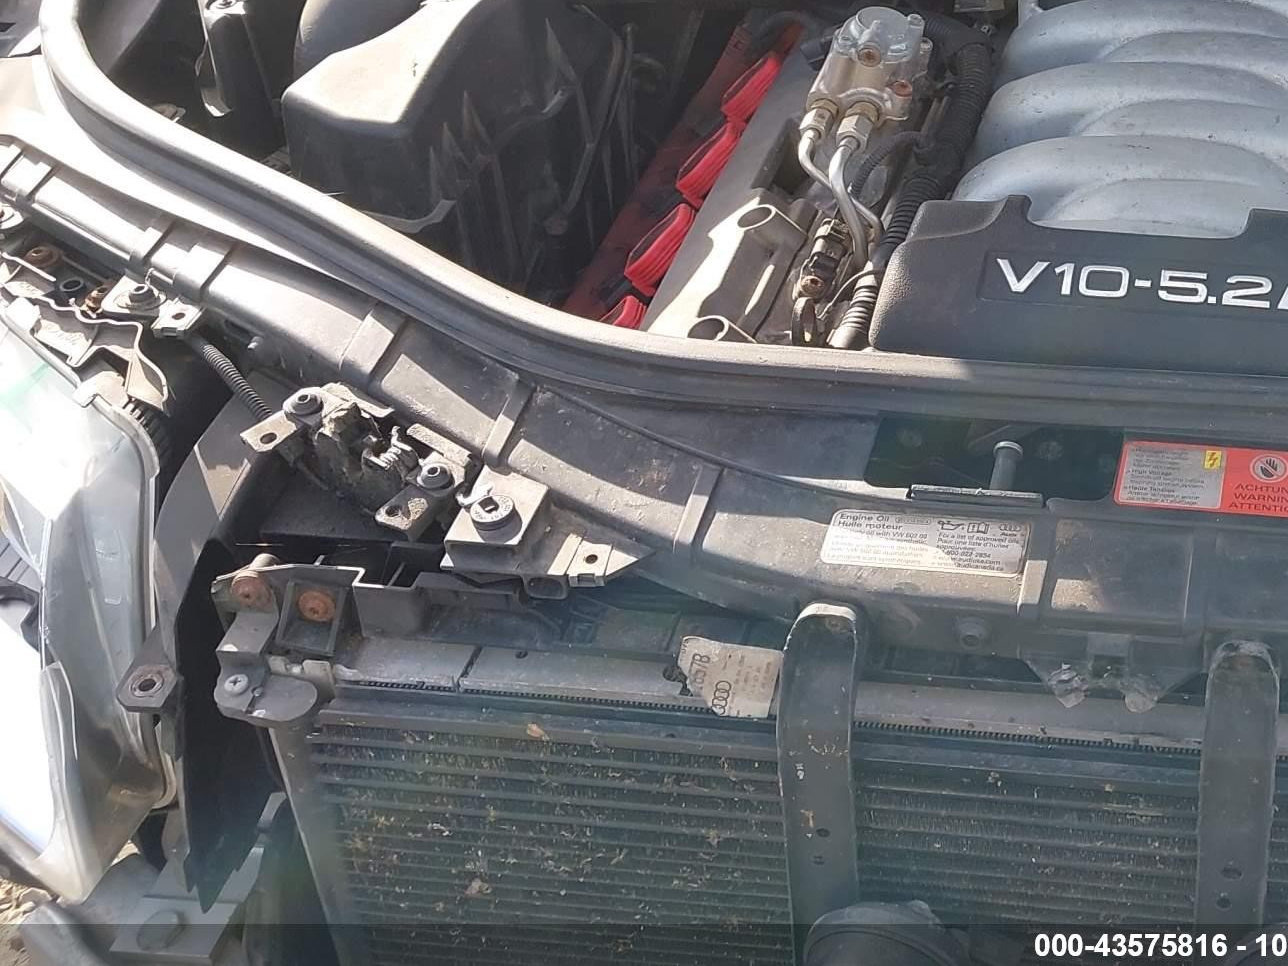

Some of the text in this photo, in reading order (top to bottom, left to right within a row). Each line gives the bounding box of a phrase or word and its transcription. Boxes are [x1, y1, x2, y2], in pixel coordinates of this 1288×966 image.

[997, 258, 1274, 309] V10-5.2
[839, 513, 874, 522] Engine
[876, 514, 890, 522] Oil
[865, 522, 903, 530] moteur
[975, 535, 1007, 544] approved
